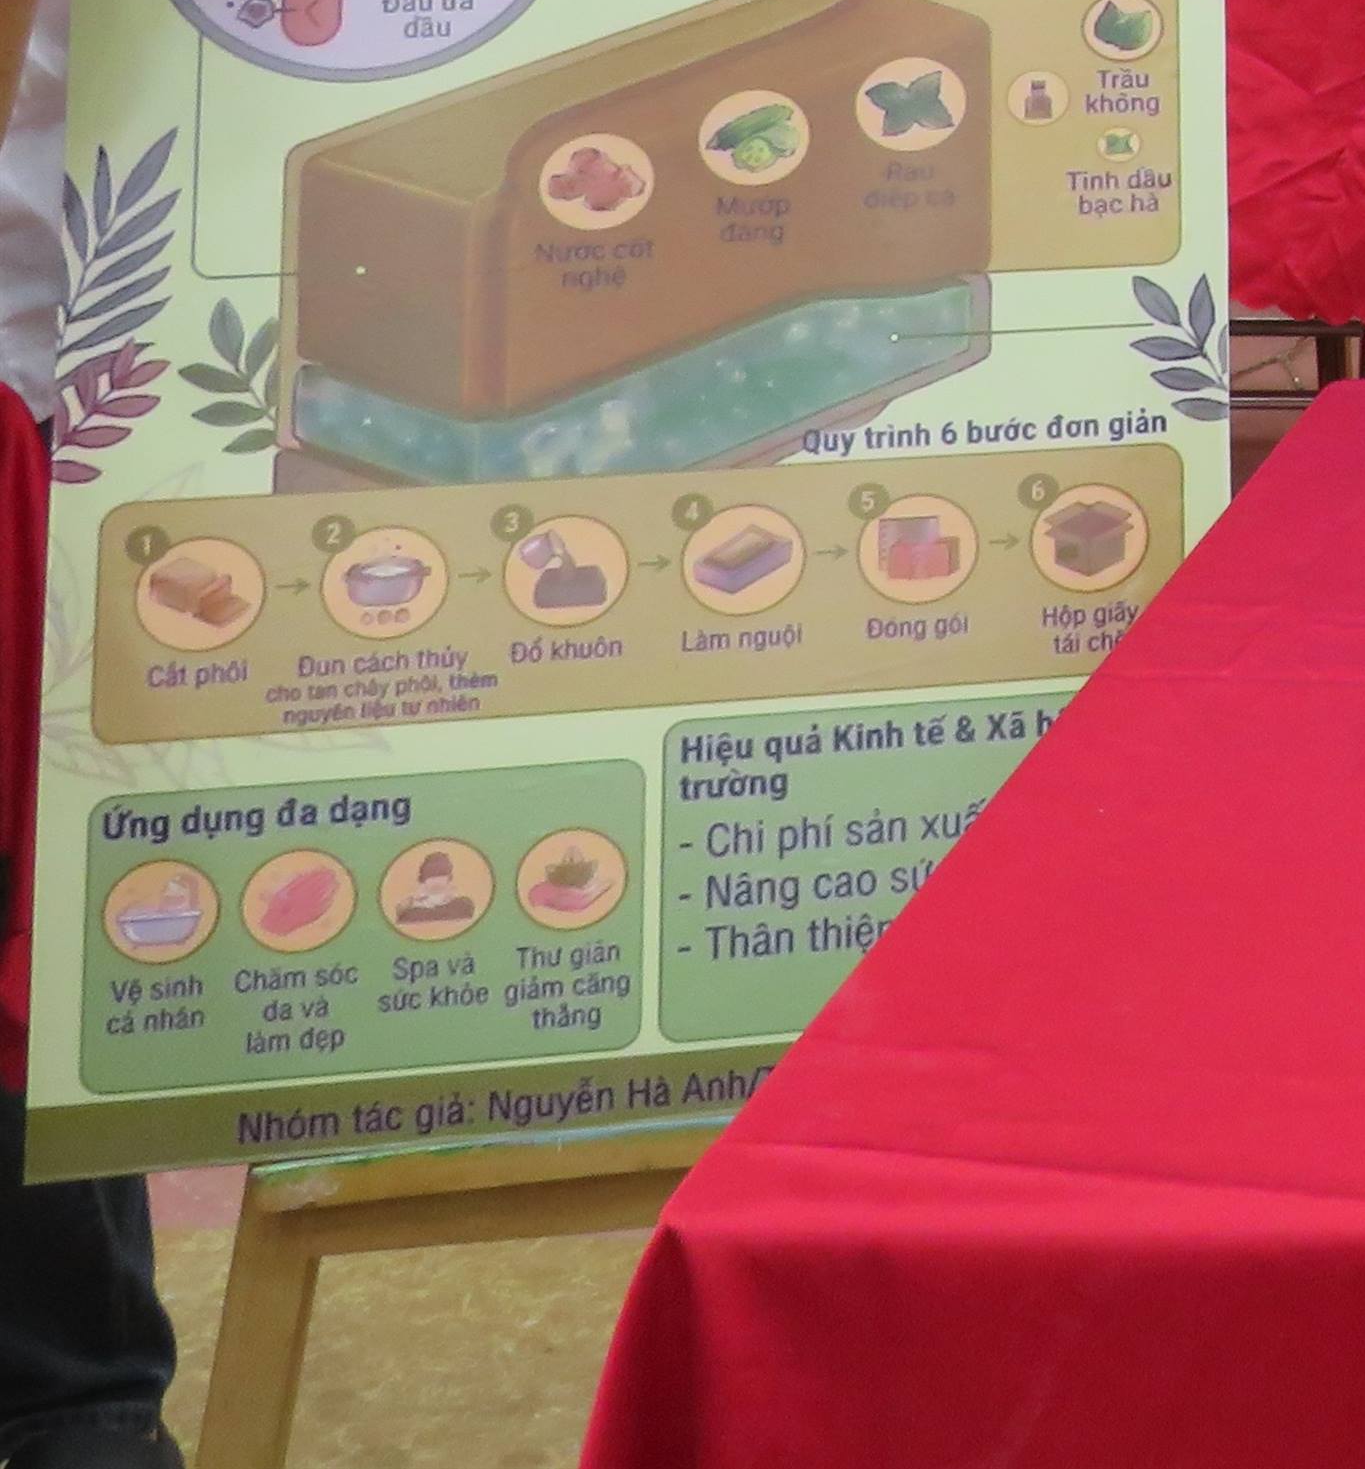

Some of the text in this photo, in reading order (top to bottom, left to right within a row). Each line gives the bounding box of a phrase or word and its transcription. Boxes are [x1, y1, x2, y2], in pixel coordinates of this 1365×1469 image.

[802, 410, 1168, 457] Quy trình 6 bước đơn giản
[102, 794, 411, 842] Ứng dụng đa dạng
